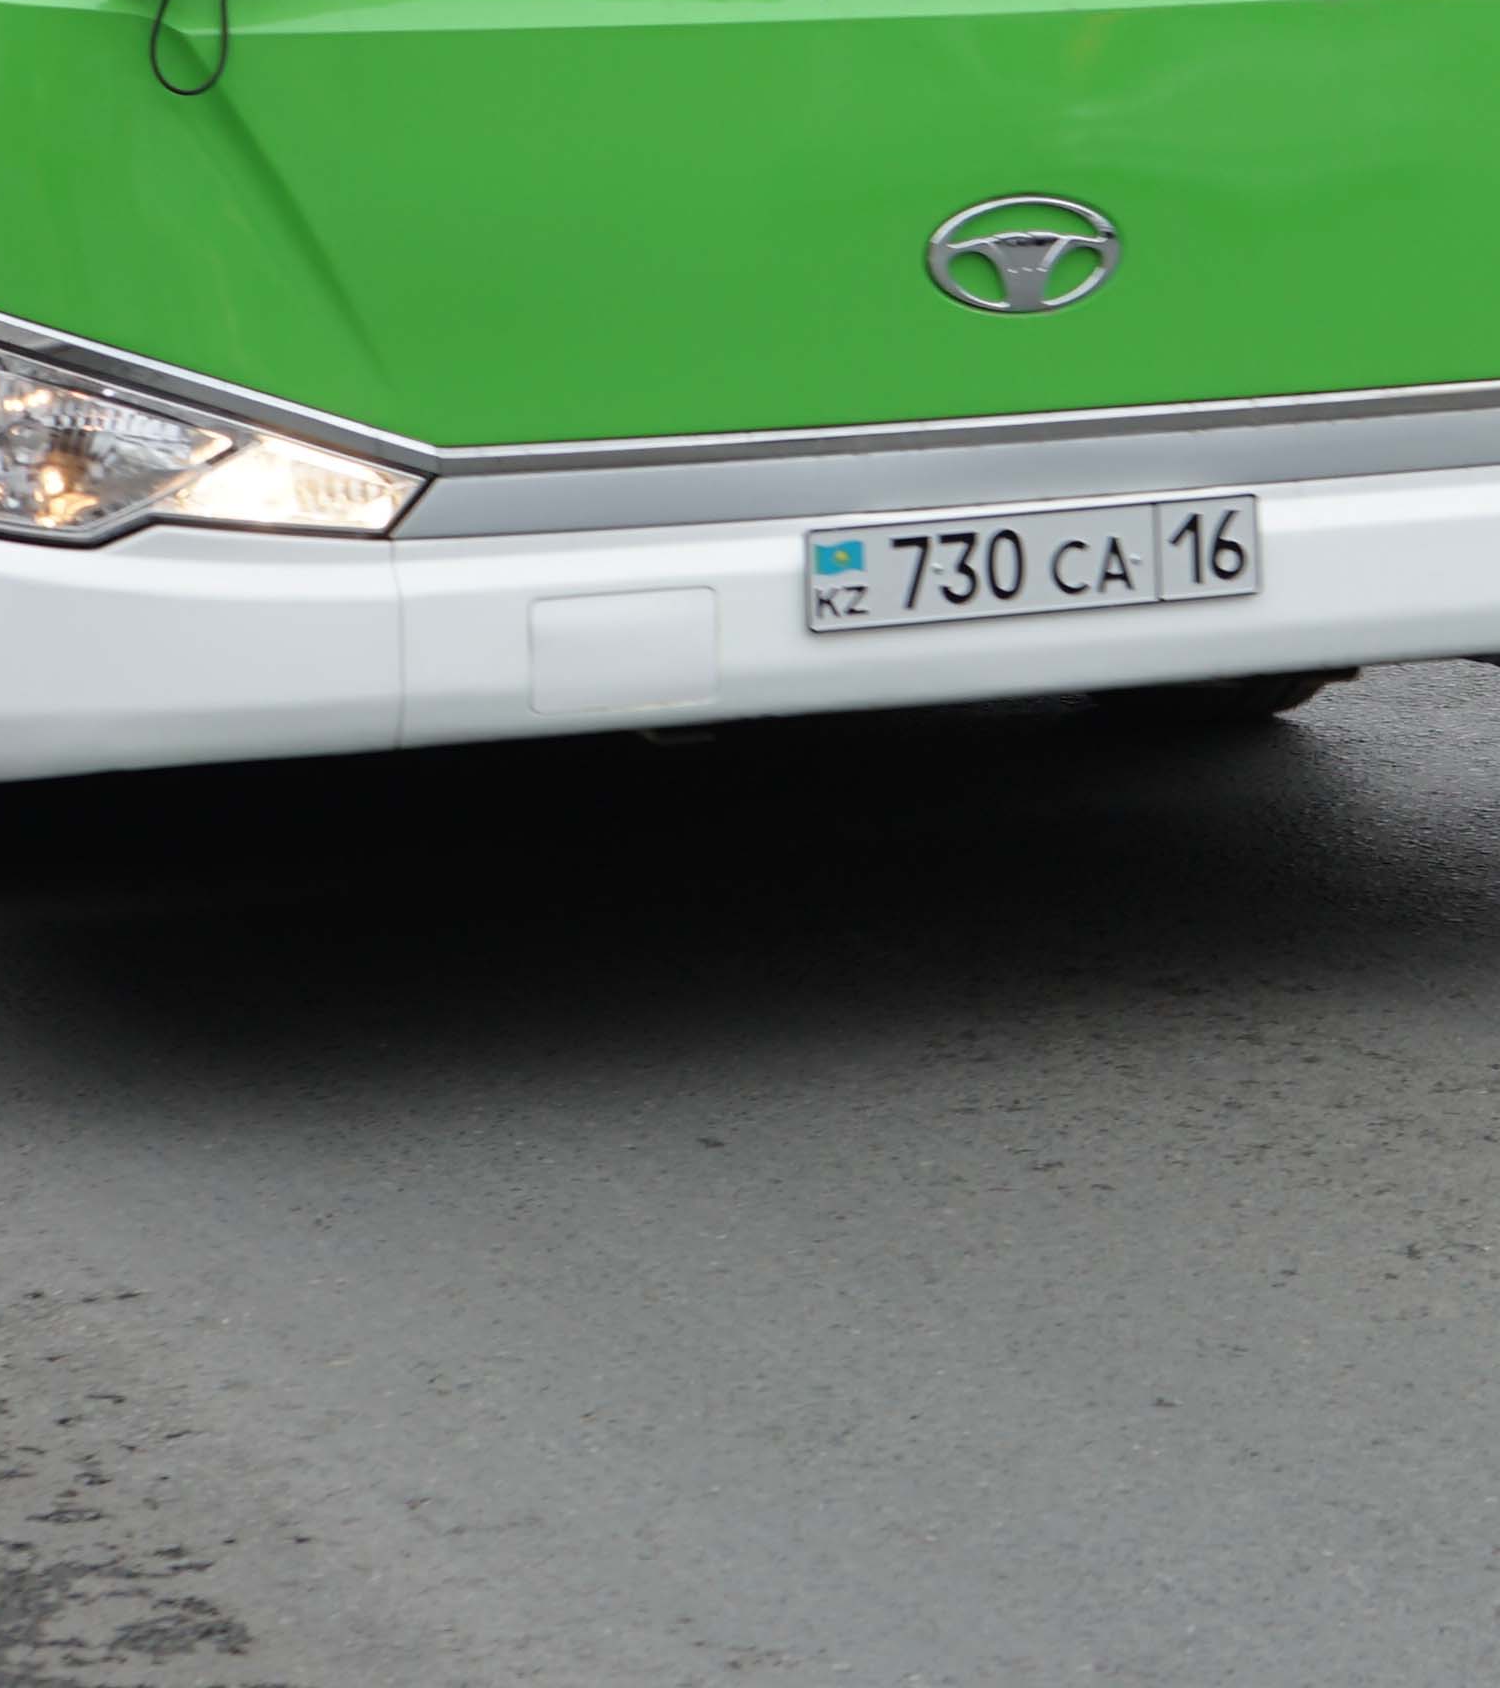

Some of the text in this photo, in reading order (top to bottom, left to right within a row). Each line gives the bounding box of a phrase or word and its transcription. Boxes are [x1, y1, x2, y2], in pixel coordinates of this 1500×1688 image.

[817, 509, 1247, 619] KZ 730 CA 16
